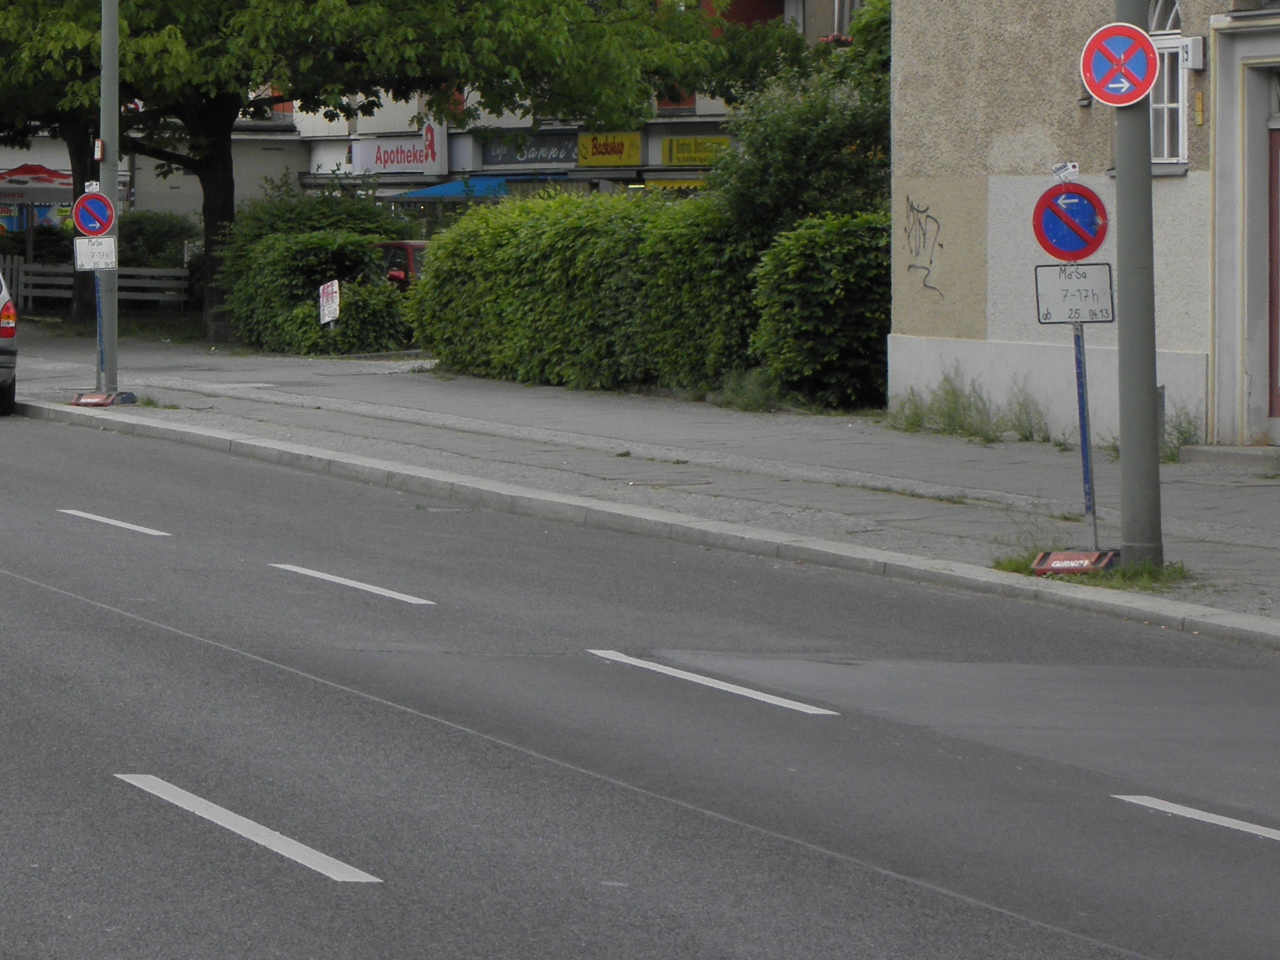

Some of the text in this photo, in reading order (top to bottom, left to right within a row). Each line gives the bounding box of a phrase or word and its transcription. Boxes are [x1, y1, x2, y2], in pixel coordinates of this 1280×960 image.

[1181, 43, 1189, 64] 19
[375, 144, 425, 170] Apotheke
[591, 135, 625, 160] Backshop
[1042, 307, 1052, 321] ab
